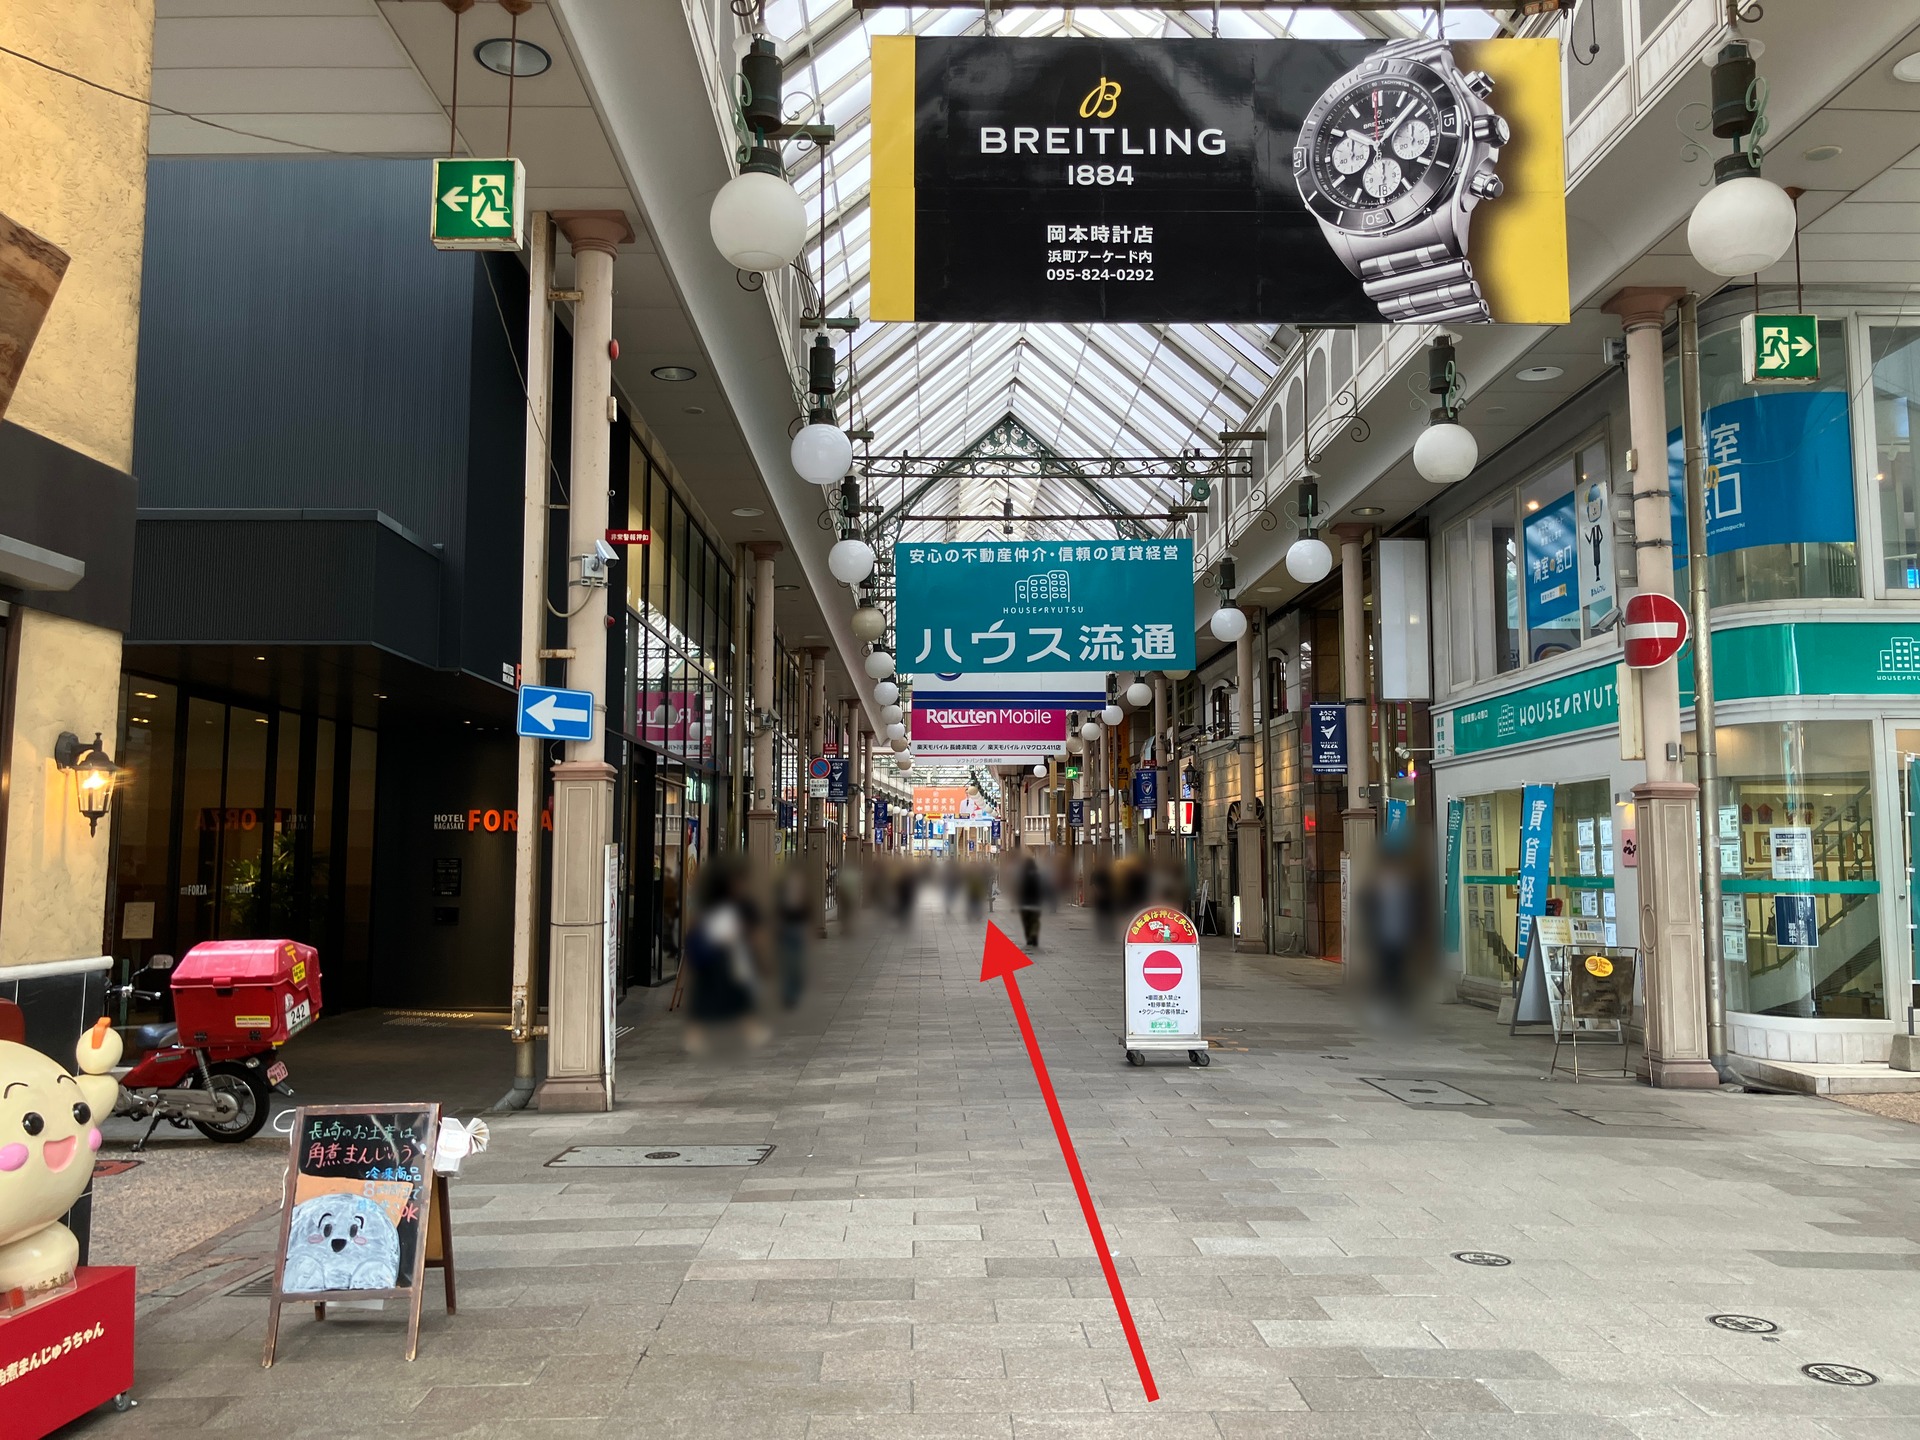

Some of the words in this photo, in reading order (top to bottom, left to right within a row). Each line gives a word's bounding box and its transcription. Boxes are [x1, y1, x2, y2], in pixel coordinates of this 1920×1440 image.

[980, 127, 1227, 156] BREITLING
[1067, 164, 1136, 186] 1884
[1046, 225, 1154, 245] 岡本時計店
[1047, 249, 1153, 264] 浜町アーケード内
[1046, 268, 1154, 282] 095-824-0292
[1716, 521, 1746, 534] madoguchi
[909, 546, 1179, 564] 安心の不動産仲介・信頼の賃貸経営
[915, 619, 1177, 664] ハウス流通
[926, 709, 997, 729] Rakuten
[999, 709, 1051, 725] Mobile
[1519, 697, 1562, 727] HOUSE
[434, 814, 465, 823] HOTEL
[467, 809, 553, 832] FORA
[1519, 799, 1548, 946] 賃貸経営
[188, 885, 207, 896] FORZA
[290, 1004, 306, 1025] 242
[309, 1121, 416, 1141] 長崎のお土産は
[305, 1143, 413, 1168] 角煮まんじゅう
[365, 1166, 422, 1182] 冷凍商品
